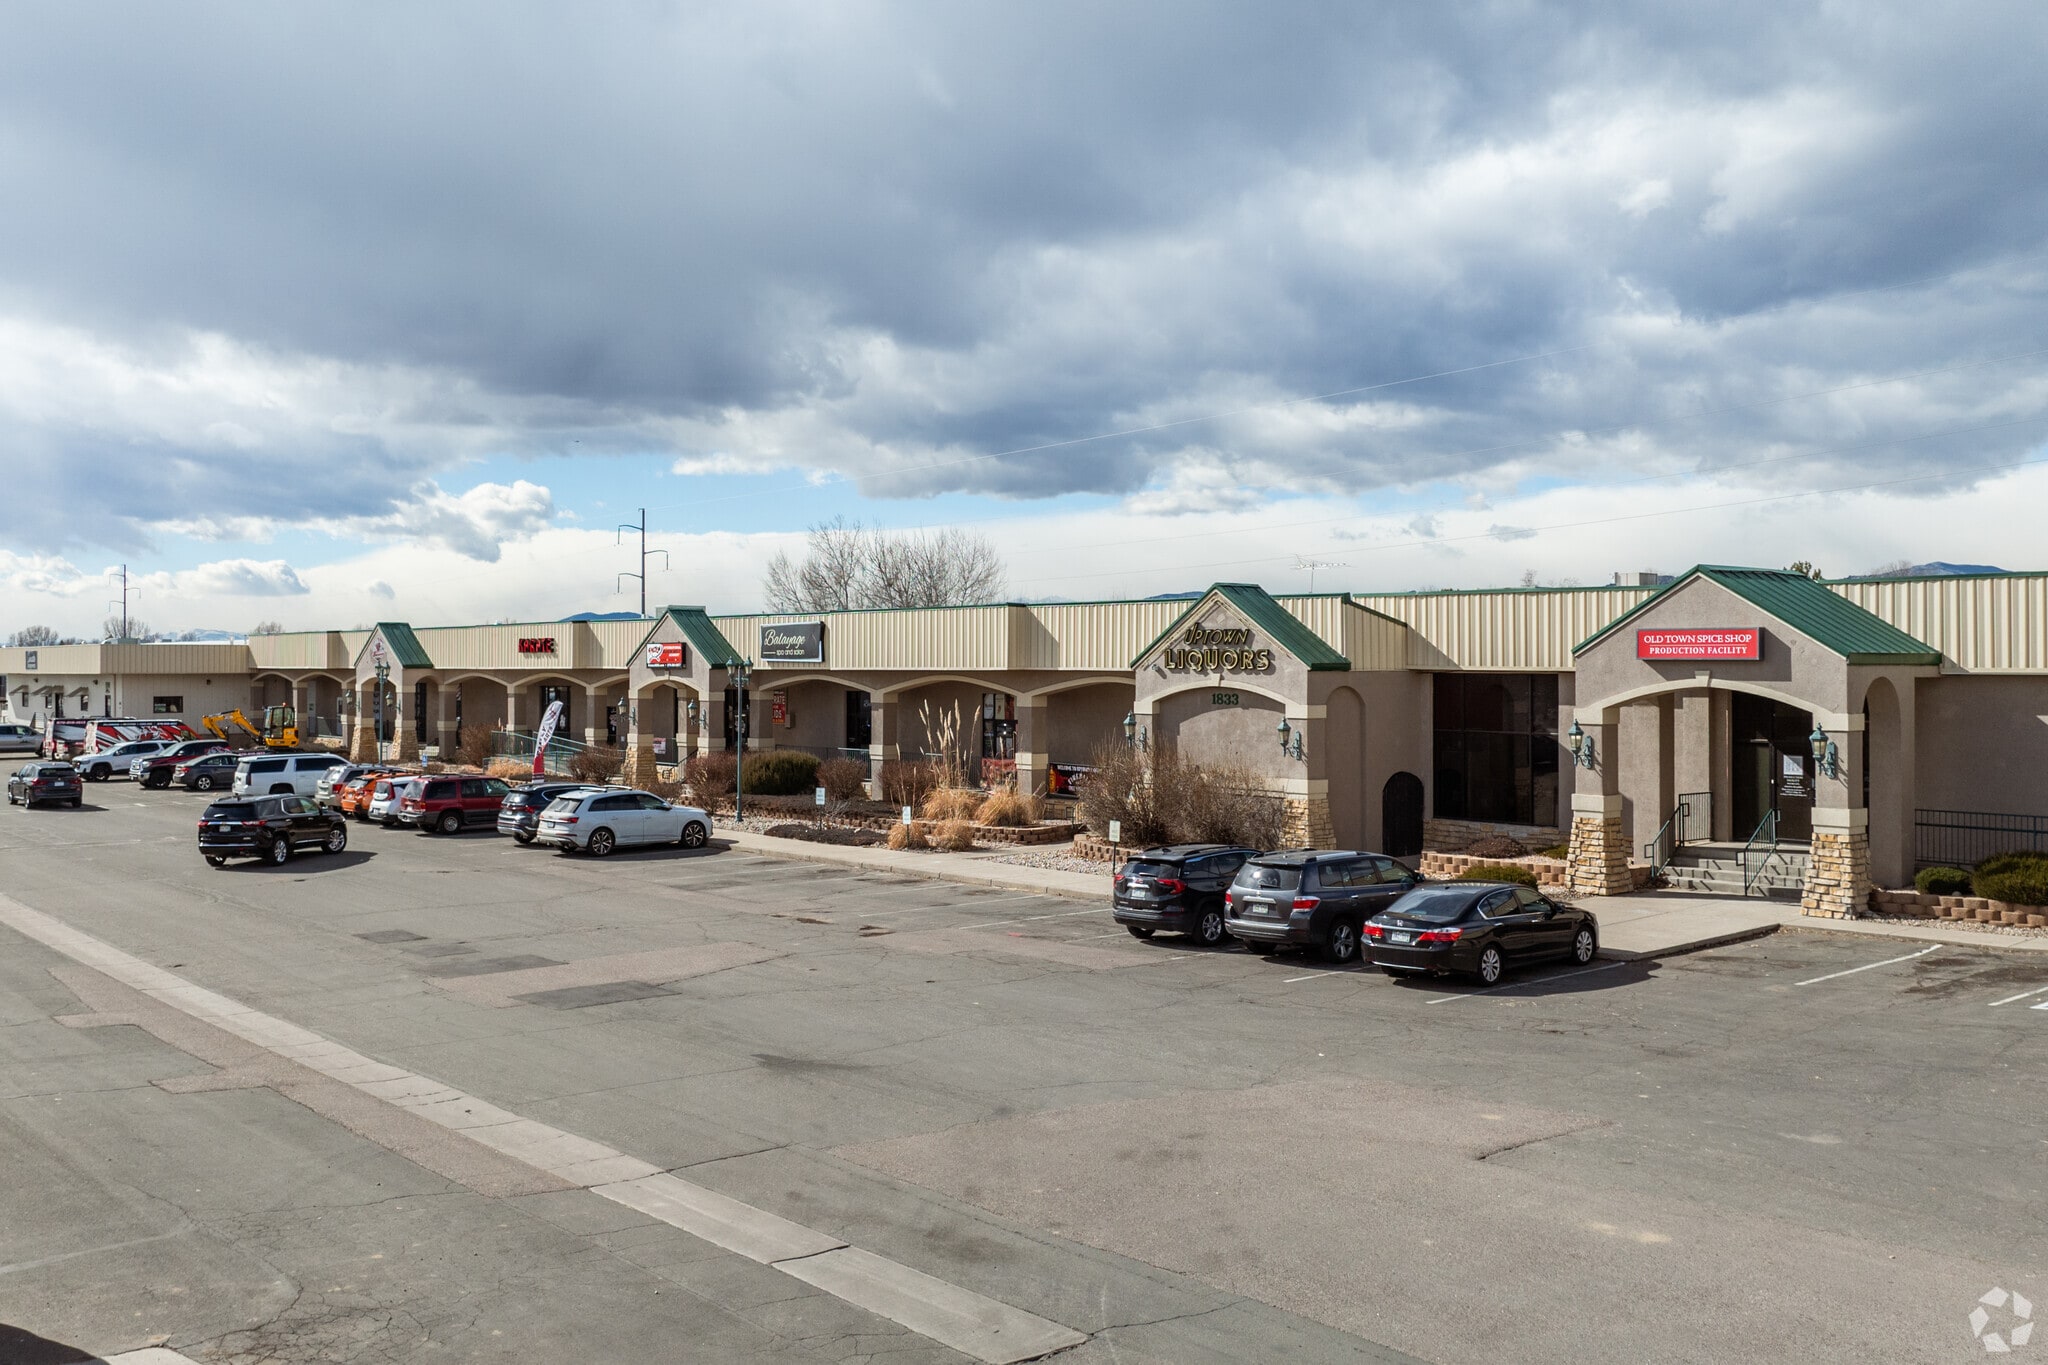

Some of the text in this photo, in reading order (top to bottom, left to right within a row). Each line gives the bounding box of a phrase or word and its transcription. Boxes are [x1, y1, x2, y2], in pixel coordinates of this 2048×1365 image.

[764, 629, 806, 649] Balayage
[1184, 622, 1250, 645] UPTOWN
[1643, 634, 1752, 644] OLD TOWN SPICE SHOP
[1649, 646, 1748, 655] PRODUCTION FACILITY
[1164, 648, 1271, 672] LIQUORS
[1212, 693, 1239, 705] 1833
